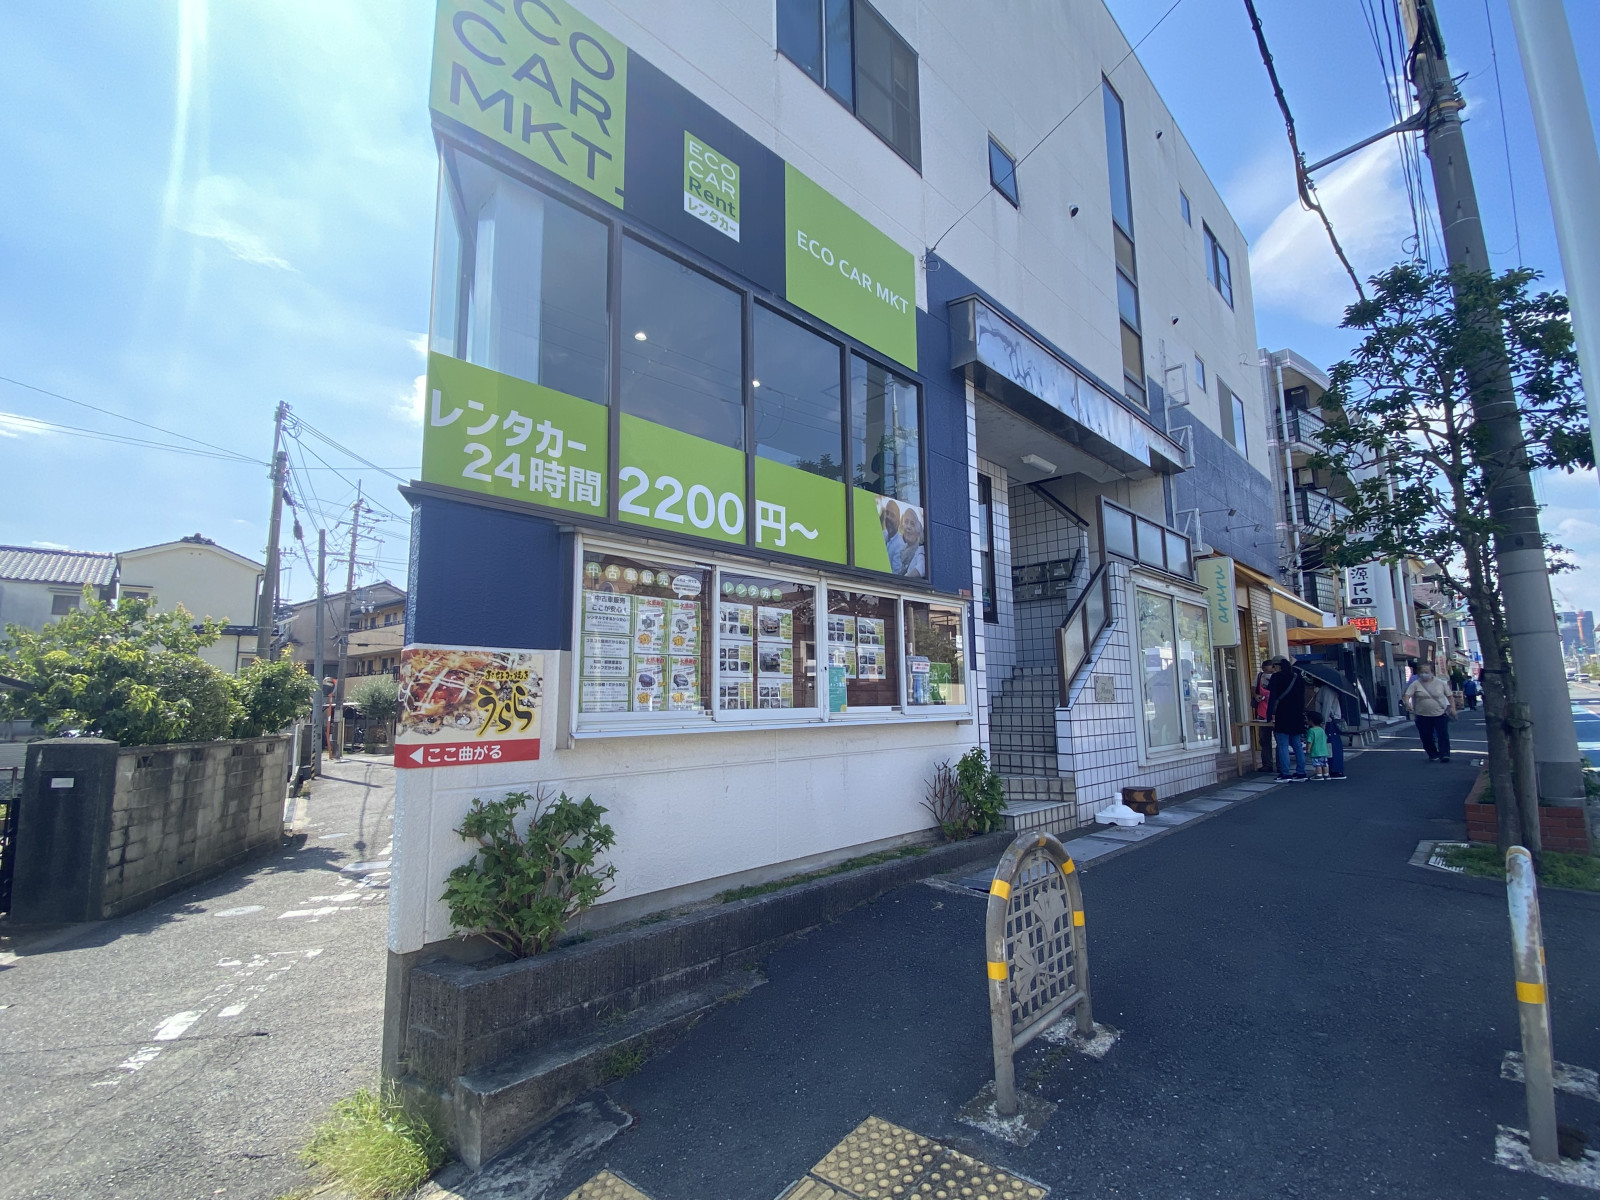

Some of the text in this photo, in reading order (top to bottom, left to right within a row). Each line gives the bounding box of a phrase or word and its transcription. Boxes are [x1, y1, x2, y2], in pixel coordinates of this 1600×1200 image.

[483, 0, 615, 80] CO
[453, 11, 612, 138] CAR
[689, 140, 736, 180] ECO
[689, 160, 735, 199] CAR
[688, 197, 736, 231] レンタカー
[689, 176, 736, 218] Rent
[797, 230, 909, 314] ECO CAR MKT
[431, 389, 586, 458] レンタカー
[462, 442, 601, 507] 24時間
[589, 564, 669, 586] 中古車販売
[725, 584, 780, 598] レンタカー
[1214, 565, 1229, 623] aruru
[485, 669, 529, 680] お好み焼き
[478, 685, 533, 736] うらら
[427, 745, 502, 763] ここ曲がる
